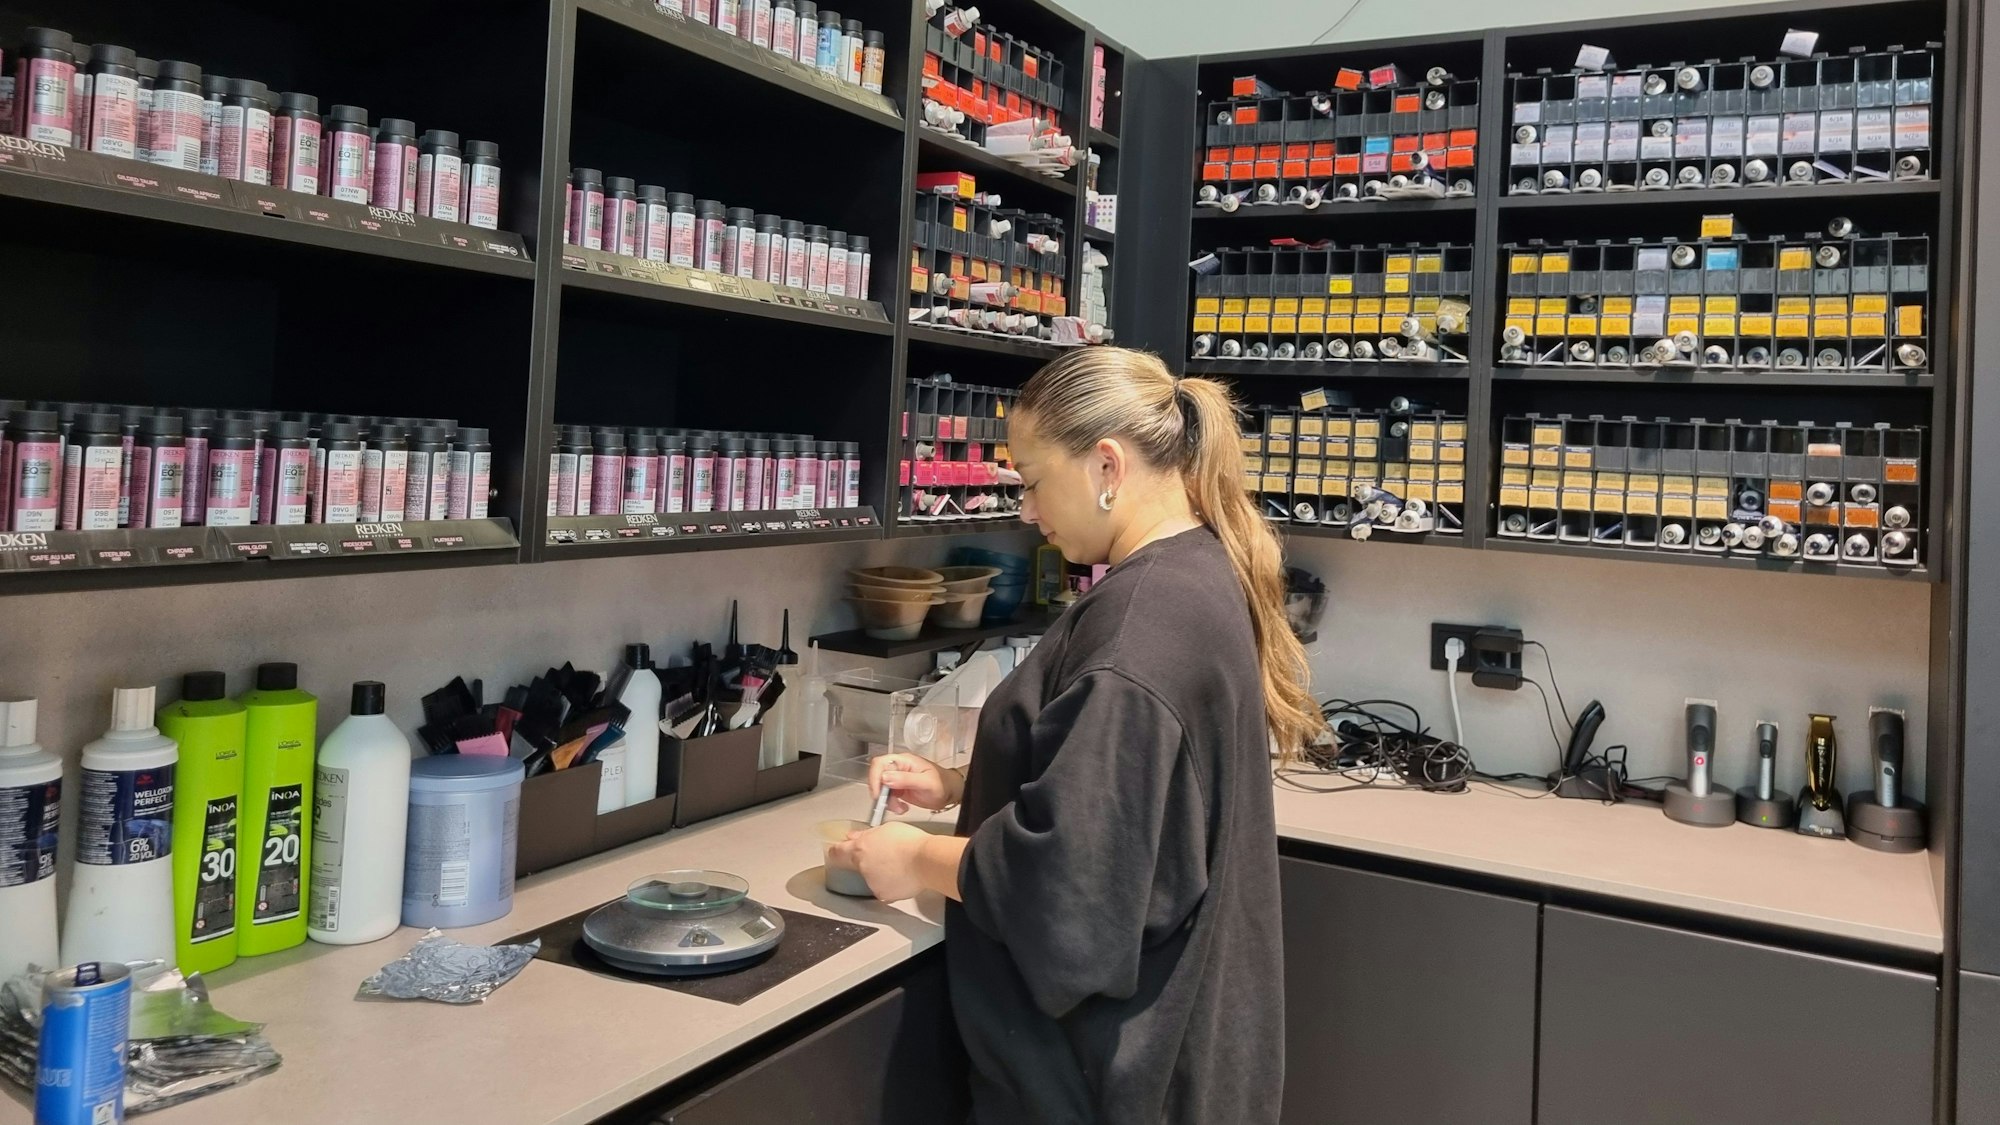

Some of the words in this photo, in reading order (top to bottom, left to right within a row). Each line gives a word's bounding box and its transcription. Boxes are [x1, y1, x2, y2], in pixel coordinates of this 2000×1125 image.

[0, 134, 66, 158] REDKEN
[299, 138, 312, 147] EQ
[338, 150, 350, 158] EQ
[369, 206, 415, 224] REDKEN
[161, 468, 175, 477] EQ
[210, 469, 223, 478] EQ
[284, 468, 298, 476] EQ
[625, 515, 658, 524] REDKEN
[355, 523, 403, 535] REDKEN
[99, 550, 131, 558] STERLING
[166, 547, 194, 555] CHROME
[30, 554, 50, 562] CAFE
[60, 553, 76, 561] LAIT
[134, 794, 167, 807] PERFECT
[129, 838, 149, 853] 6%
[264, 834, 300, 867] 20
[129, 852, 140, 862] 20
[201, 847, 236, 882] 30
